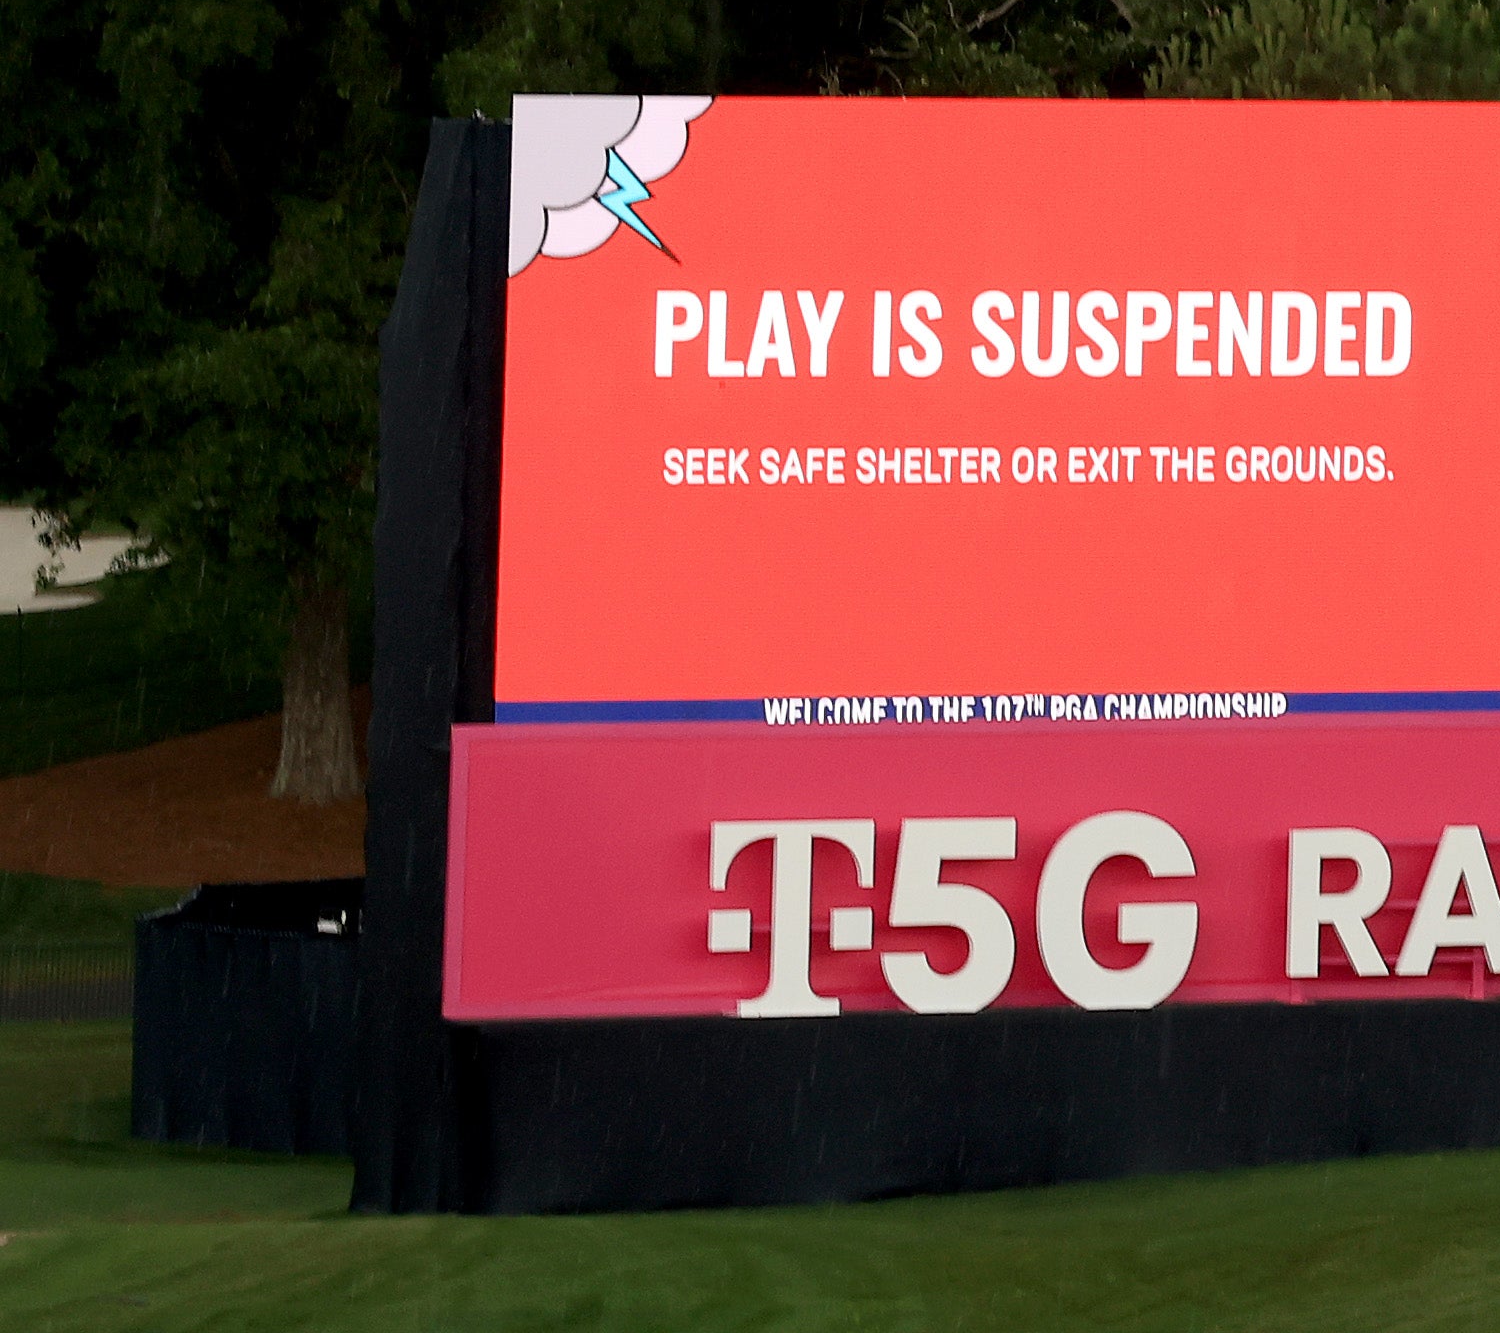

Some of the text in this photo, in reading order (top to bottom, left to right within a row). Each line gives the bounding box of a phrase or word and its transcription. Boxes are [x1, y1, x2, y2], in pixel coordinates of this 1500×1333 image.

[653, 290, 1412, 378] PLAY IS SUSPENDED
[663, 445, 1394, 485] SEEK SAFE SHELTER OR EXIT THE GROUNDS.
[893, 696, 923, 723] TO
[928, 695, 976, 723] THE
[1051, 694, 1098, 721] PGA
[1104, 692, 1287, 721] CHAMPIONSHIP
